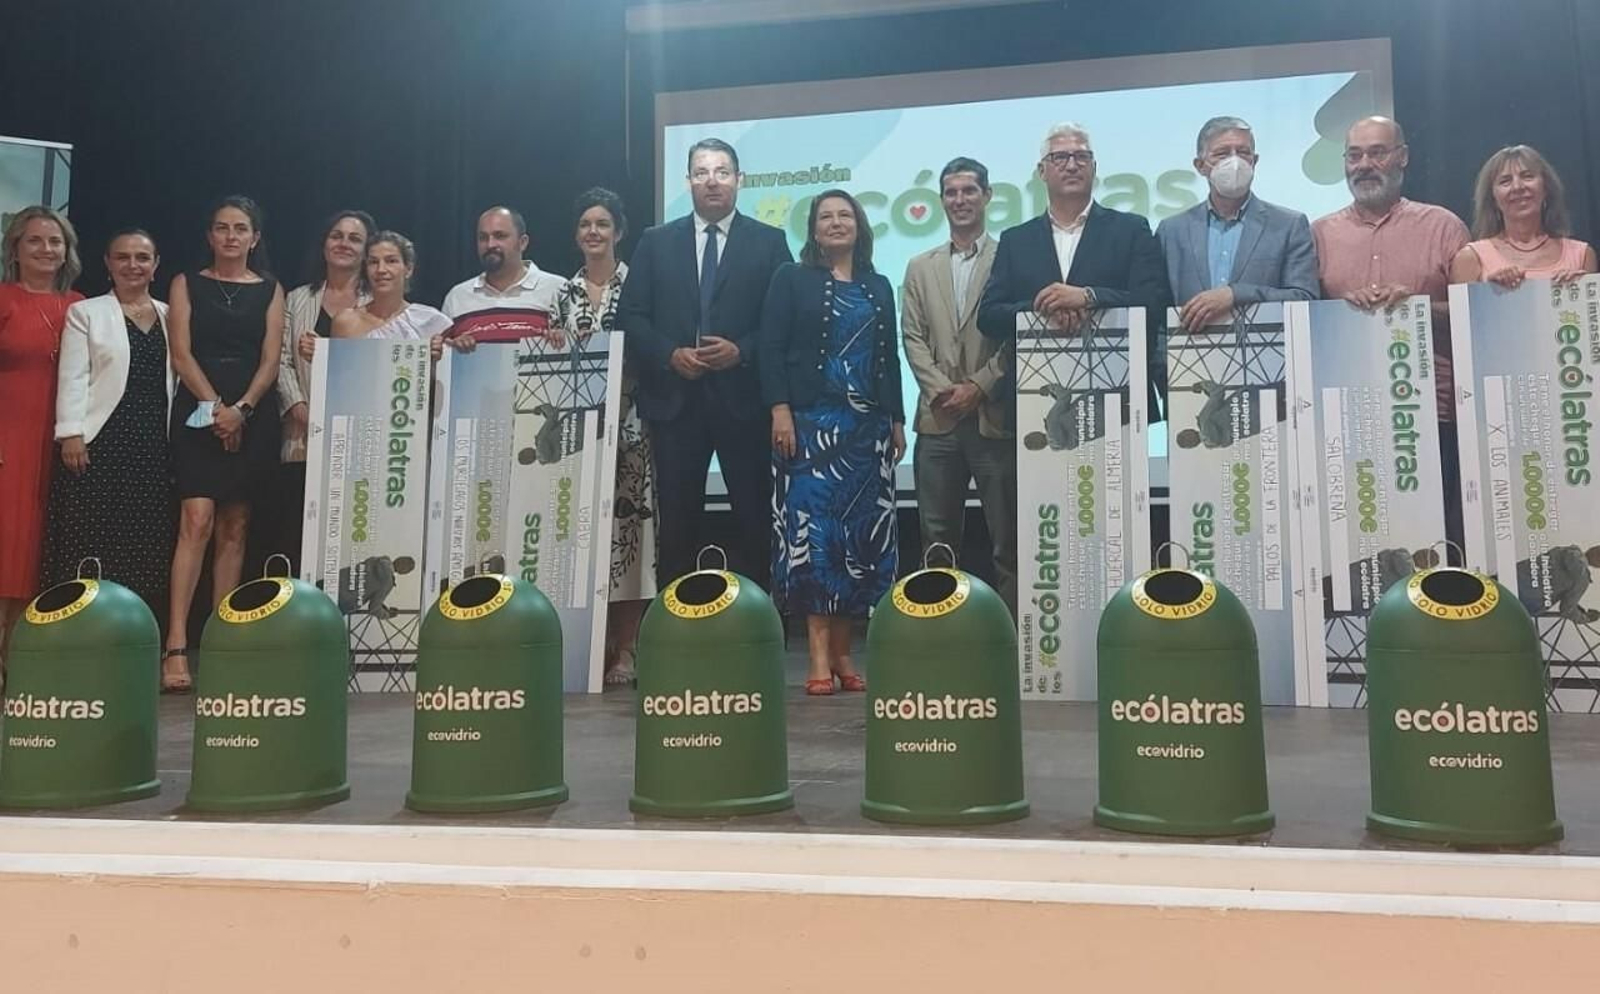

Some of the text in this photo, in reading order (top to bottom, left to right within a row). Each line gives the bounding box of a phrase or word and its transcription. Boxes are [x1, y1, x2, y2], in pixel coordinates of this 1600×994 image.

[742, 163, 851, 188] nvasión
[1415, 303, 1430, 379] La invasión
[1586, 282, 1600, 364] La invasión
[416, 360, 426, 411] invasión
[1556, 310, 1593, 486] #ecólatras
[1075, 400, 1086, 451] municipio
[1086, 395, 1096, 439] ecólatra
[1230, 397, 1241, 447] municipio
[1241, 391, 1250, 436] ecólatra
[1388, 329, 1422, 492] #ecólatras
[1529, 402, 1541, 447] cheque
[386, 366, 416, 509] #ecólatras
[1077, 465, 1095, 538] 1.000€
[1232, 462, 1251, 536] 1.000€
[1326, 437, 1347, 521] SALOBREÑA
[1356, 459, 1378, 534] 1.000€
[1487, 424, 1512, 541] X LOS ANIMALES
[1522, 450, 1547, 530] 1.000€
[352, 479, 369, 542] 1.000€
[476, 480, 493, 542] 1.000€
[555, 477, 571, 542] 1.000€
[1108, 506, 1121, 520] DE
[1260, 426, 1281, 582] PALOS DE LA FRONTERA
[578, 505, 591, 550] CABRA
[1369, 549, 1383, 605] municipio
[1528, 533, 1540, 589] Ganadora
[1540, 555, 1555, 608] Iniciativa
[462, 595, 504, 617] VIDRIO
[692, 593, 734, 616] VIDRIO
[894, 591, 965, 615] SOLO VIDRIO
[1031, 503, 1061, 669] #ecólatras
[1135, 592, 1214, 616] SOLO VIDRIO
[1360, 561, 1372, 609] ecólatra
[1413, 592, 1497, 617] SOLO VIDRIO
[238, 600, 281, 621] VIDRIO
[1021, 613, 1032, 694] La invasión
[415, 685, 526, 712] ecólatras
[1038, 675, 1048, 693] de
[1051, 671, 1062, 694] los
[873, 690, 998, 721] ecólatras
[1110, 693, 1246, 726] ecólatras
[1394, 701, 1539, 734] ecólatras
[9, 734, 56, 749] ecovidrio
[206, 733, 260, 748] ecovidrio
[427, 728, 481, 742] ecovidrio
[663, 733, 723, 748] ecovidrio
[895, 738, 957, 754] ecovidrio
[1136, 743, 1205, 759] ecovidrio
[1429, 752, 1502, 769] ecovidrio
